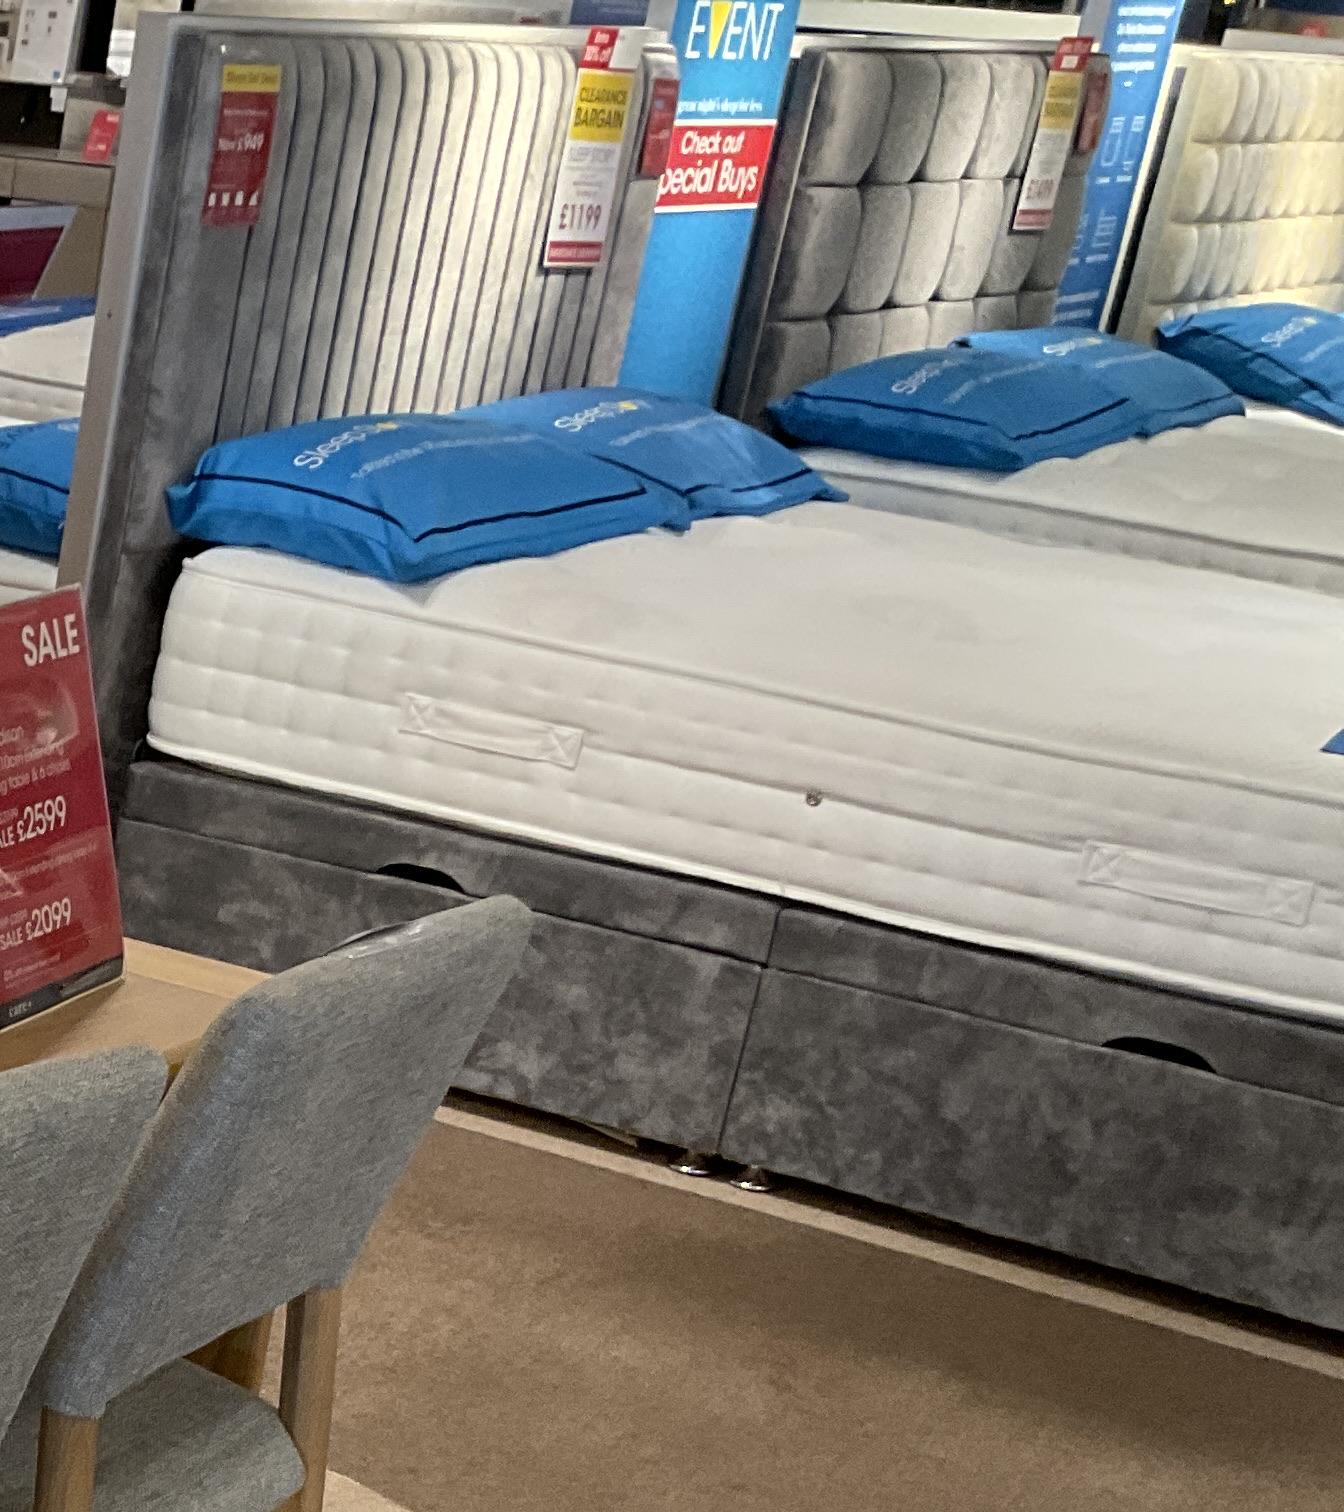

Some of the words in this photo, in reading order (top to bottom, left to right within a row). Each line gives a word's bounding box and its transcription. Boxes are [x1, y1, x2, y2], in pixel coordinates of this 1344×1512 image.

[685, 0, 785, 61] EVENT
[574, 107, 625, 128] BARGAIN
[681, 131, 721, 155] Check
[722, 131, 745, 154] out
[656, 160, 717, 202] pecial
[718, 159, 759, 199] Buys
[558, 203, 602, 230] £1199
[22, 613, 81, 667] SALE
[16, 795, 66, 842] £2599
[0, 927, 24, 950] SALE
[25, 897, 72, 941] £2099
